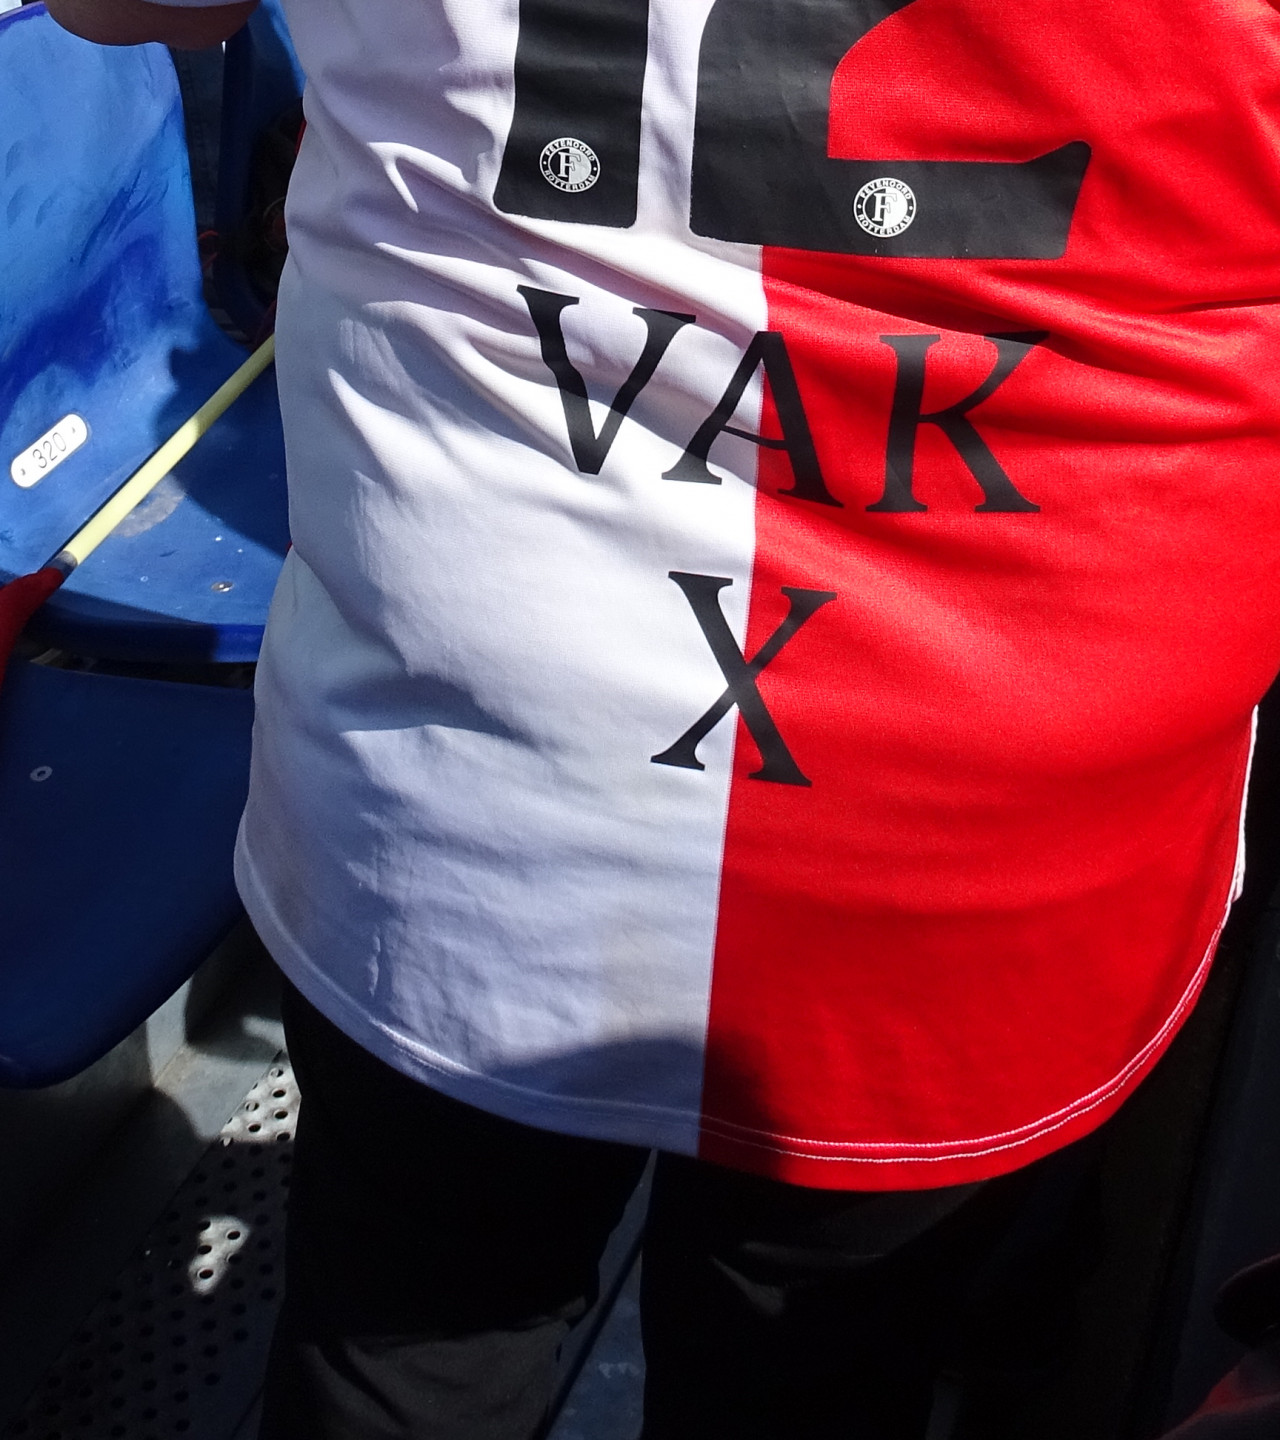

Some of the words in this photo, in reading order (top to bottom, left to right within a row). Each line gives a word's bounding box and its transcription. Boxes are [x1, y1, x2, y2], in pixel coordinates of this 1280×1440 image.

[859, 179, 912, 200] FEYENOORD
[857, 213, 912, 235] ROTTERDAM
[516, 284, 1051, 513] VAK
[32, 432, 67, 469] 320
[650, 570, 838, 788] X
